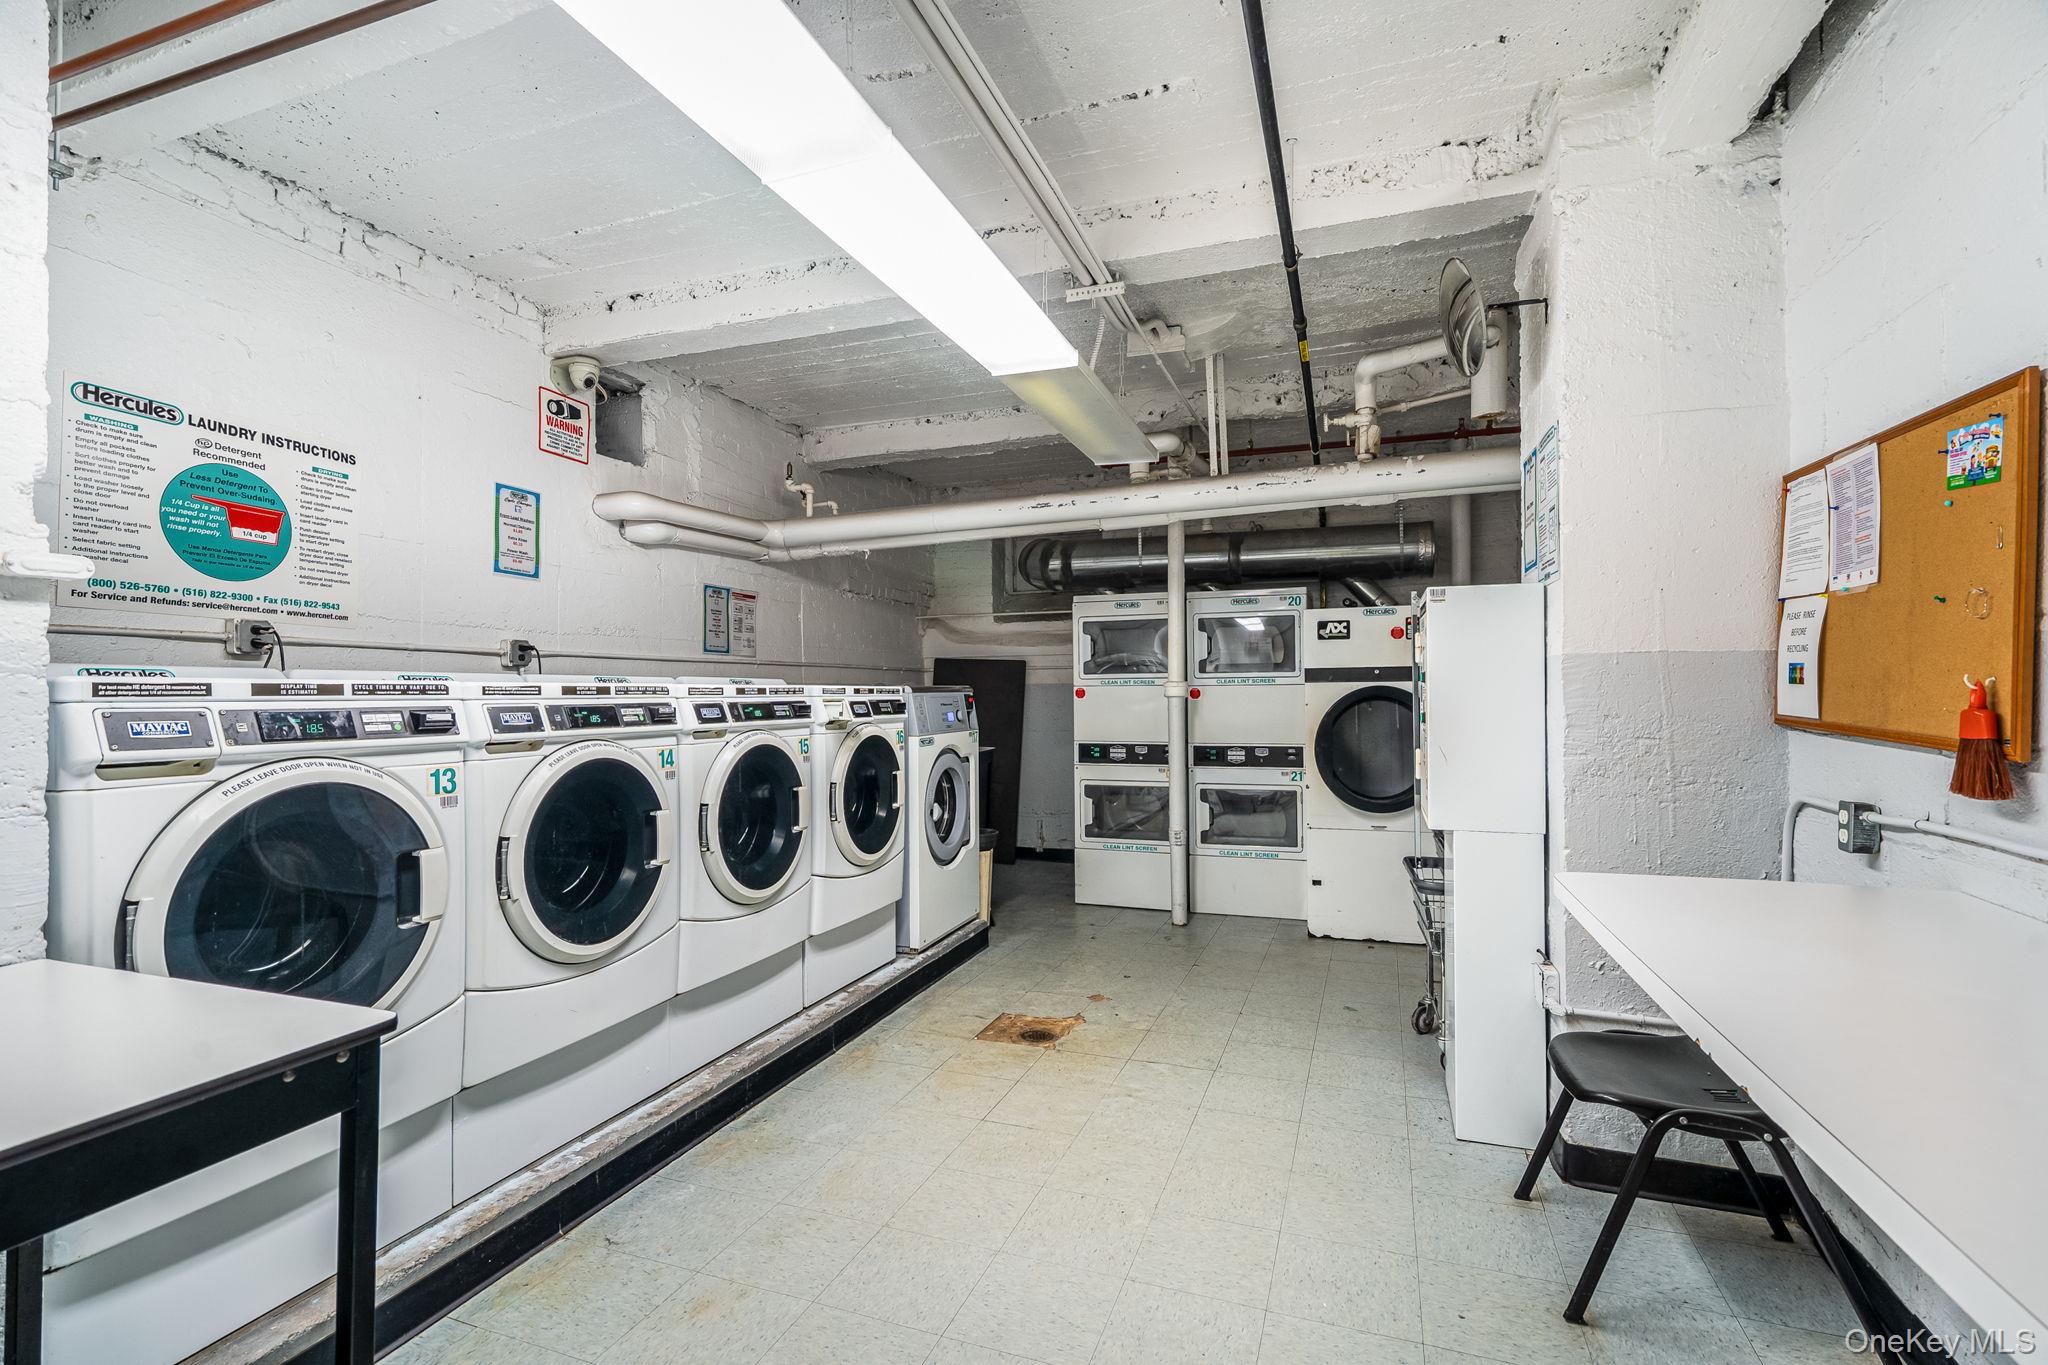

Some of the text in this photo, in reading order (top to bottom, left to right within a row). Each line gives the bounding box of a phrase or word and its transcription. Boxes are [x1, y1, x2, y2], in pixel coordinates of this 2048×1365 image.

[82, 383, 177, 421] Hercules
[75, 419, 99, 429] Check
[109, 427, 128, 436] make
[88, 414, 135, 431] WASHING
[546, 415, 583, 437] WARNING
[75, 427, 95, 435] drum
[103, 433, 125, 443] empty
[139, 441, 158, 449] clean
[75, 435, 98, 446] Empty
[109, 443, 136, 453] pockets
[188, 414, 356, 466] LAUNDRY INSTRUCTIONS
[74, 442, 150, 463] before loading clothes
[214, 442, 262, 460] Detergent
[74, 451, 90, 459] Sort
[91, 455, 117, 464] clothes
[118, 461, 146, 471] properly
[74, 458, 96, 467] better
[97, 463, 116, 471] wash
[193, 447, 266, 471] Recommended
[74, 466, 130, 480] prevent damage
[221, 468, 239, 479] Use
[73, 474, 144, 492] Load washer loosely
[189, 472, 269, 494] Less Detergent To
[73, 488, 93, 496] close
[120, 489, 137, 497] level
[179, 479, 278, 506] Prevent Over-Sudsing.
[99, 502, 129, 511] overload
[171, 498, 183, 506] 1/4
[184, 500, 201, 510] Cup
[72, 513, 94, 521] Insert
[95, 516, 122, 526] laundry
[169, 515, 190, 523] wash
[178, 509, 198, 517] need
[166, 523, 222, 538] rinse properly.
[253, 530, 268, 540] cup
[71, 536, 141, 551] Select fabric setting
[71, 545, 149, 560] Additional instructions
[87, 577, 340, 611] (800) 526-5760 (516) 822-9300 Fax (516) 822-9543
[1288, 596, 1301, 606] 20
[71, 589, 349, 621] For Service and Refunds: service@hercnet.com www.hercnet.com
[1787, 610, 1816, 620] PLEASE RINSE
[1326, 622, 1347, 633] ADC
[1791, 628, 1807, 636] BEFORE
[1787, 644, 1808, 652] RECYCLING
[130, 722, 187, 732] MAYTAG
[897, 730, 904, 744] 16
[799, 738, 809, 754] 15
[659, 749, 674, 768] 14
[222, 778, 254, 797] PLEASE
[253, 768, 279, 781] LEAVE
[280, 763, 303, 772] DOOR
[372, 771, 384, 779] USE
[430, 768, 456, 794] 13
[1291, 771, 1303, 781] 21
